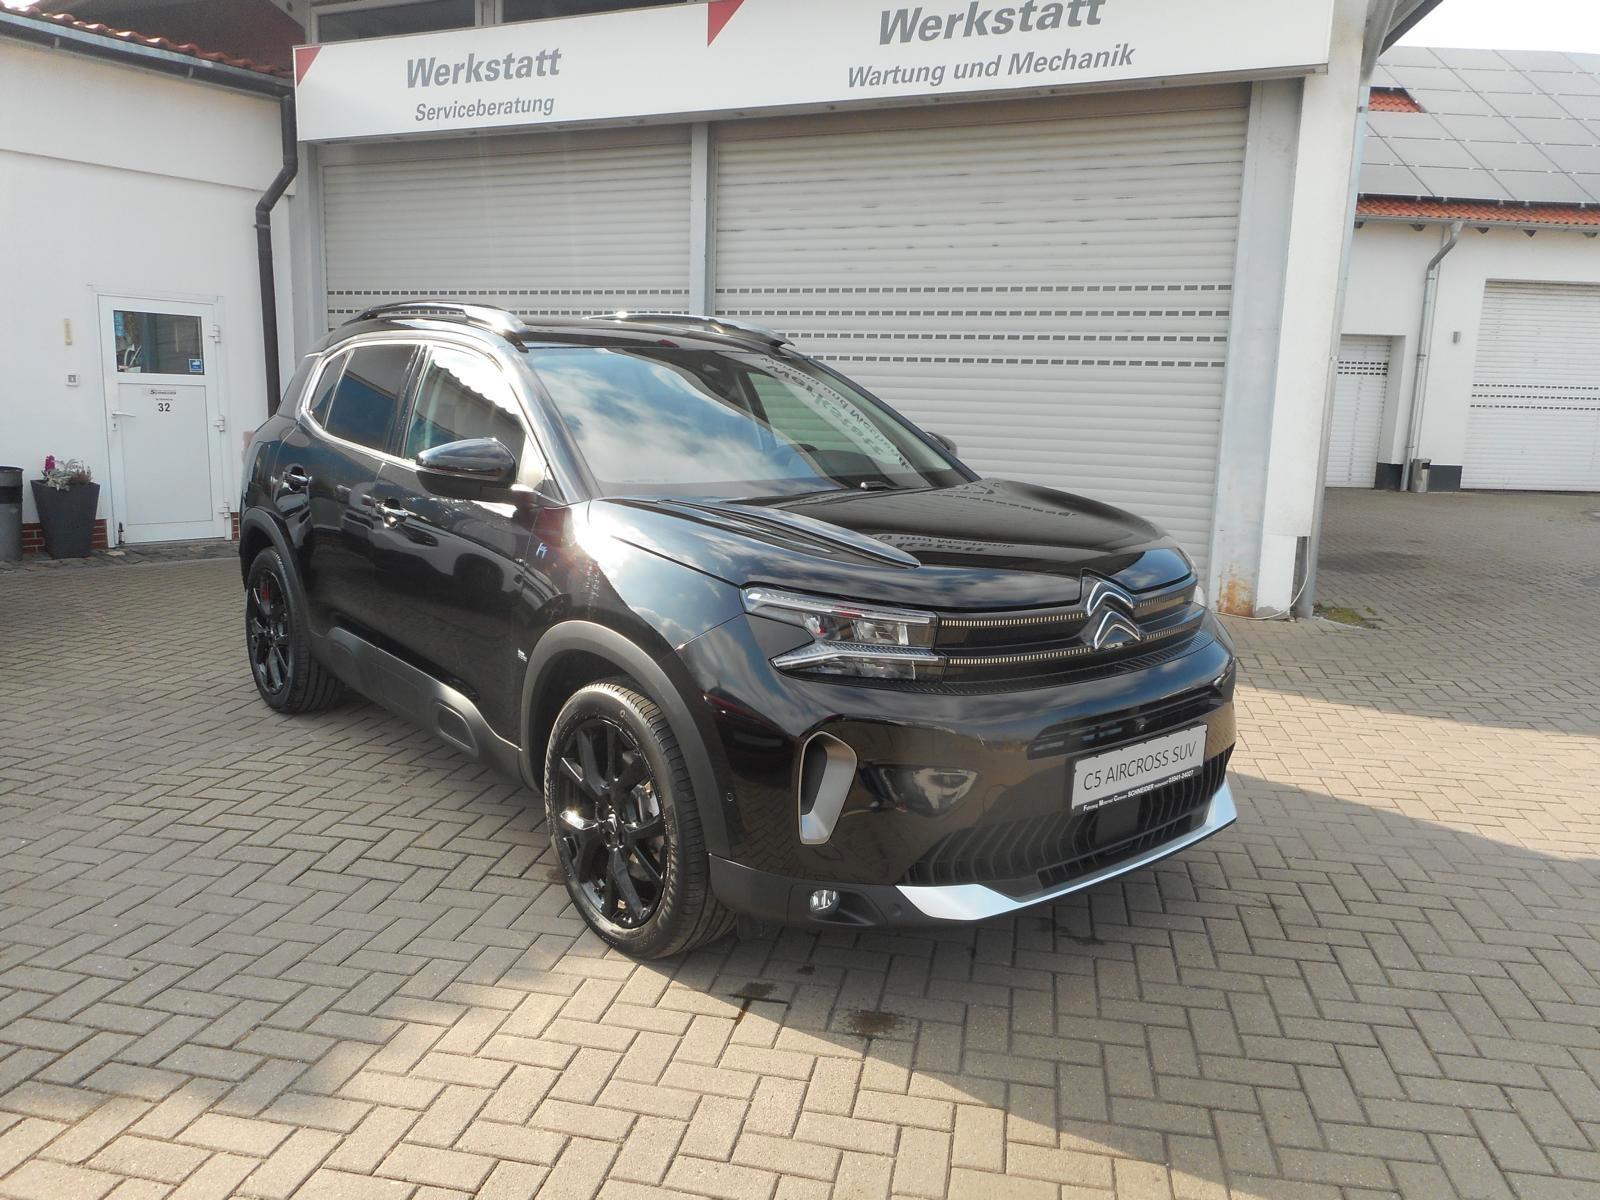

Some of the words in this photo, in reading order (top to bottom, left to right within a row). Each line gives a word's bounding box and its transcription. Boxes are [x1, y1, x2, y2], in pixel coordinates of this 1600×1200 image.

[879, 0, 1105, 45] Werkstatt
[407, 48, 562, 88] Werkstatt
[848, 64, 946, 87] Wartung
[953, 55, 1002, 80] und
[1008, 43, 1136, 76] Mechanik
[415, 97, 555, 122] Serviceberatung
[158, 402, 171, 412] 32
[1083, 770, 1102, 791] C5
[1105, 749, 1169, 785] AIRCROSS
[1171, 741, 1197, 763] SUV
